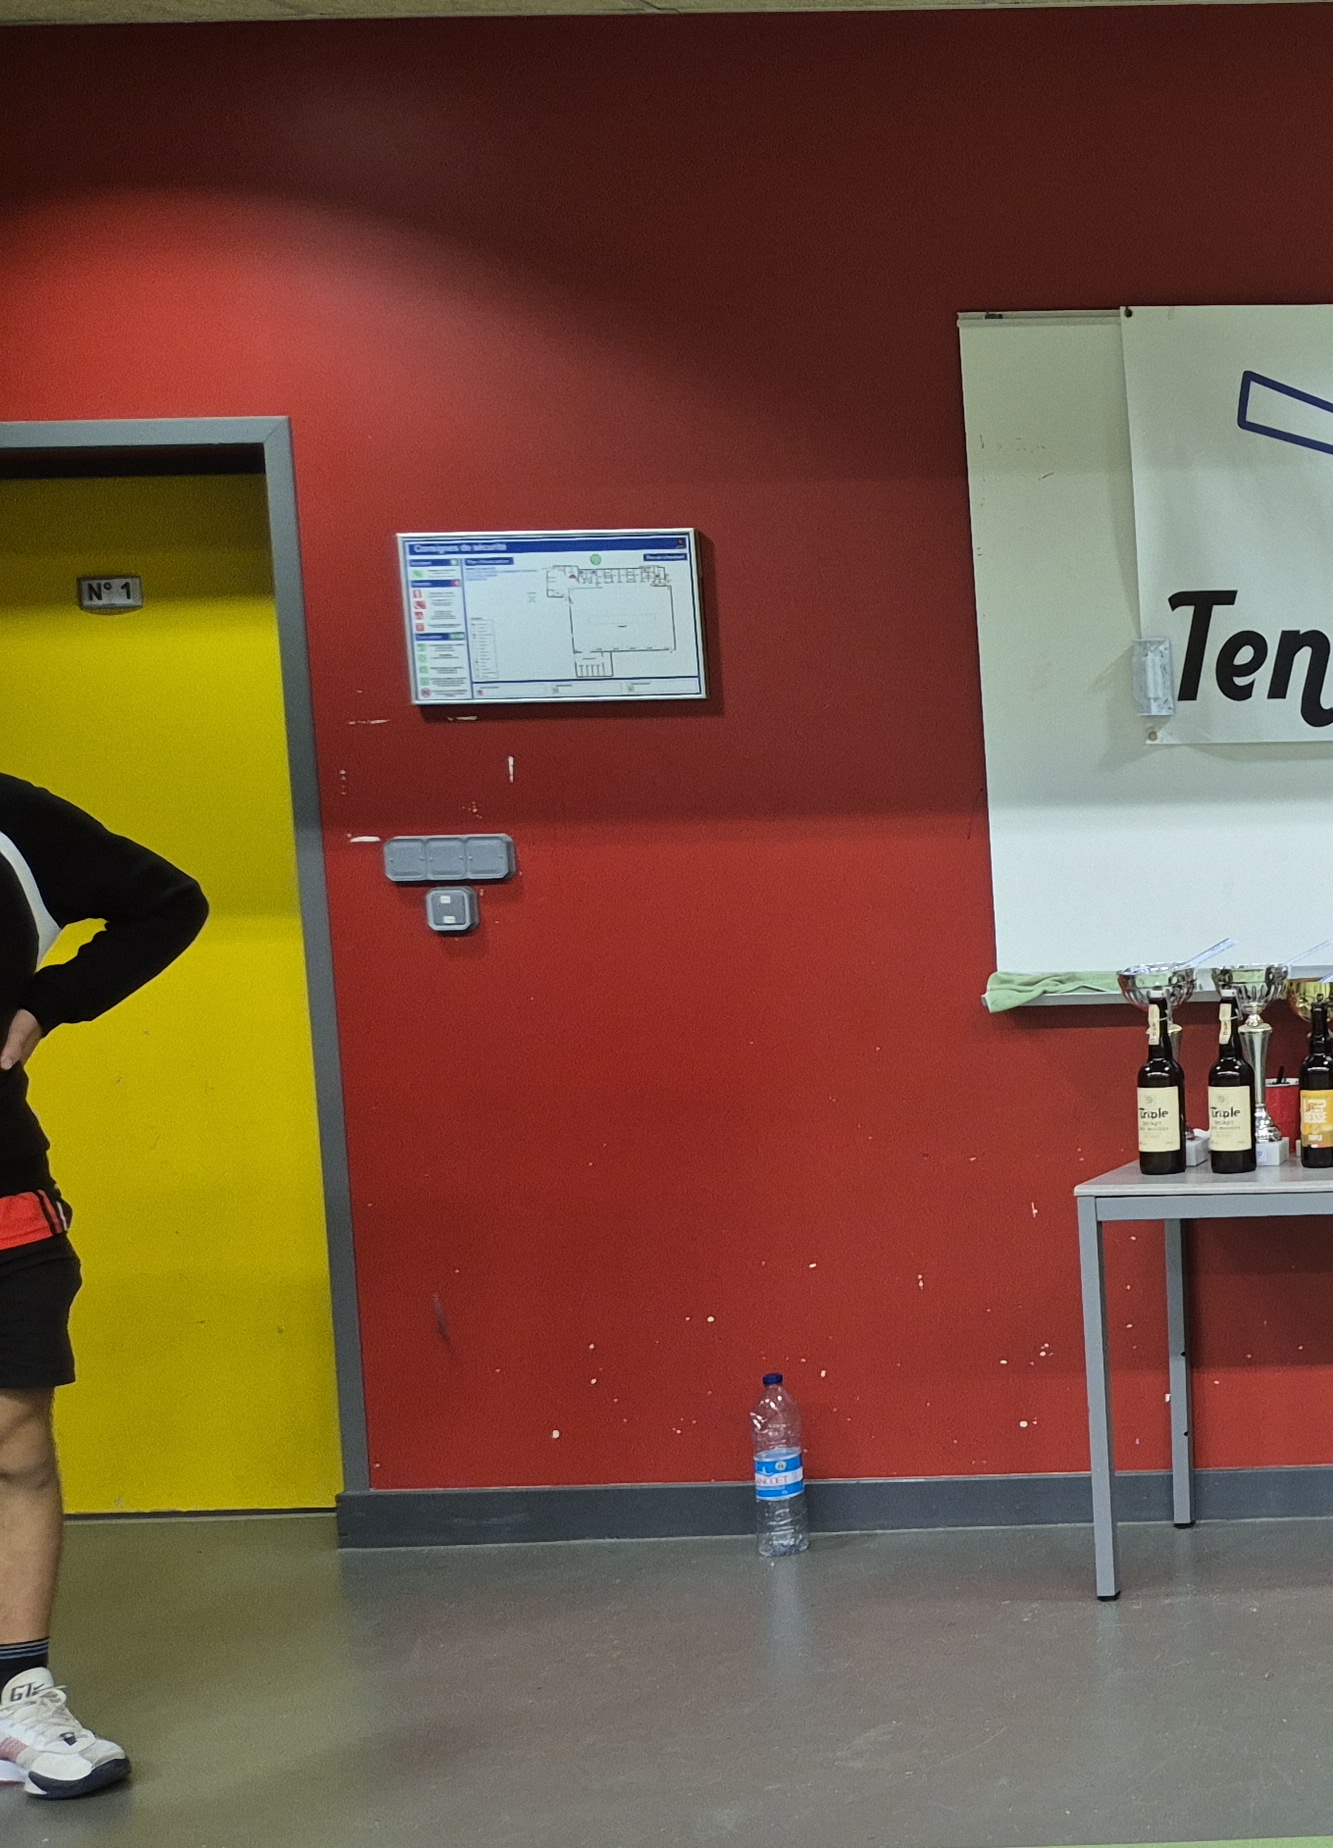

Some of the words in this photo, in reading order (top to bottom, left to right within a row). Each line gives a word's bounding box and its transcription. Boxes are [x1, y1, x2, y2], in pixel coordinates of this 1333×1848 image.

[120, 581, 131, 600] 1
[1139, 1107, 1169, 1119] Triple
[1210, 1106, 1241, 1119] Triple
